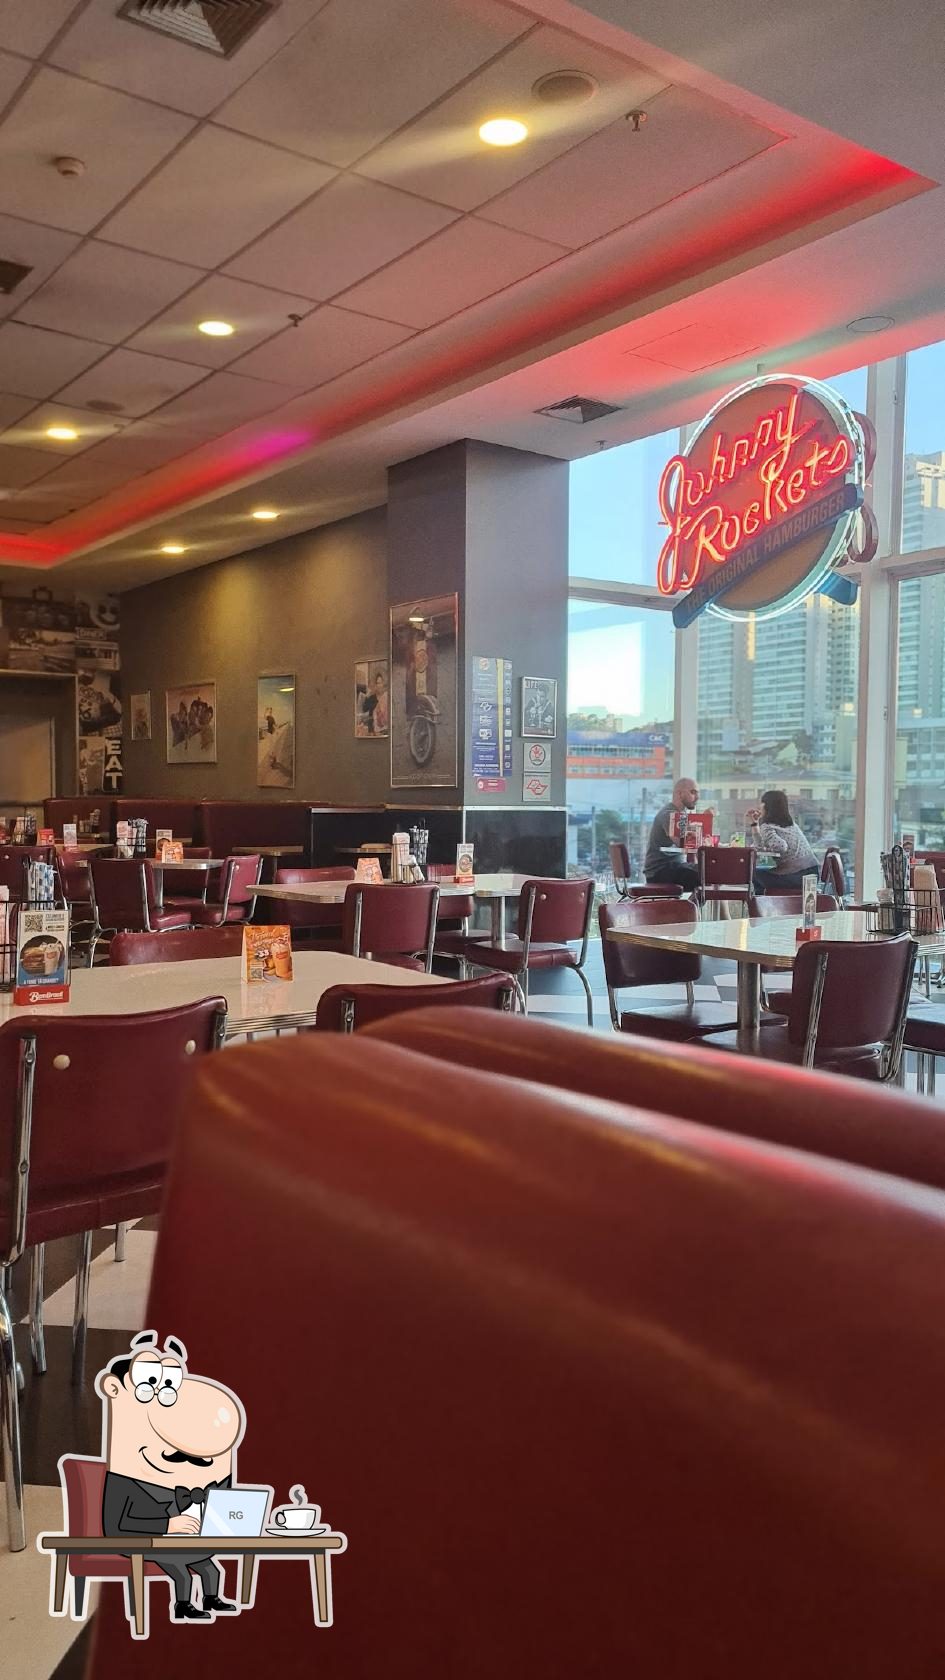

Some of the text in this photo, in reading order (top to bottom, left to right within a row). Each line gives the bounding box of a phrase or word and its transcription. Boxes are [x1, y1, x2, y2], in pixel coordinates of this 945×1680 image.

[658, 392, 818, 594] Johnny
[680, 436, 852, 590] Rockets
[687, 493, 845, 614] THE ORIGINAL HAMBURGER
[524, 680, 538, 689] LIFE
[104, 738, 123, 789] EAT
